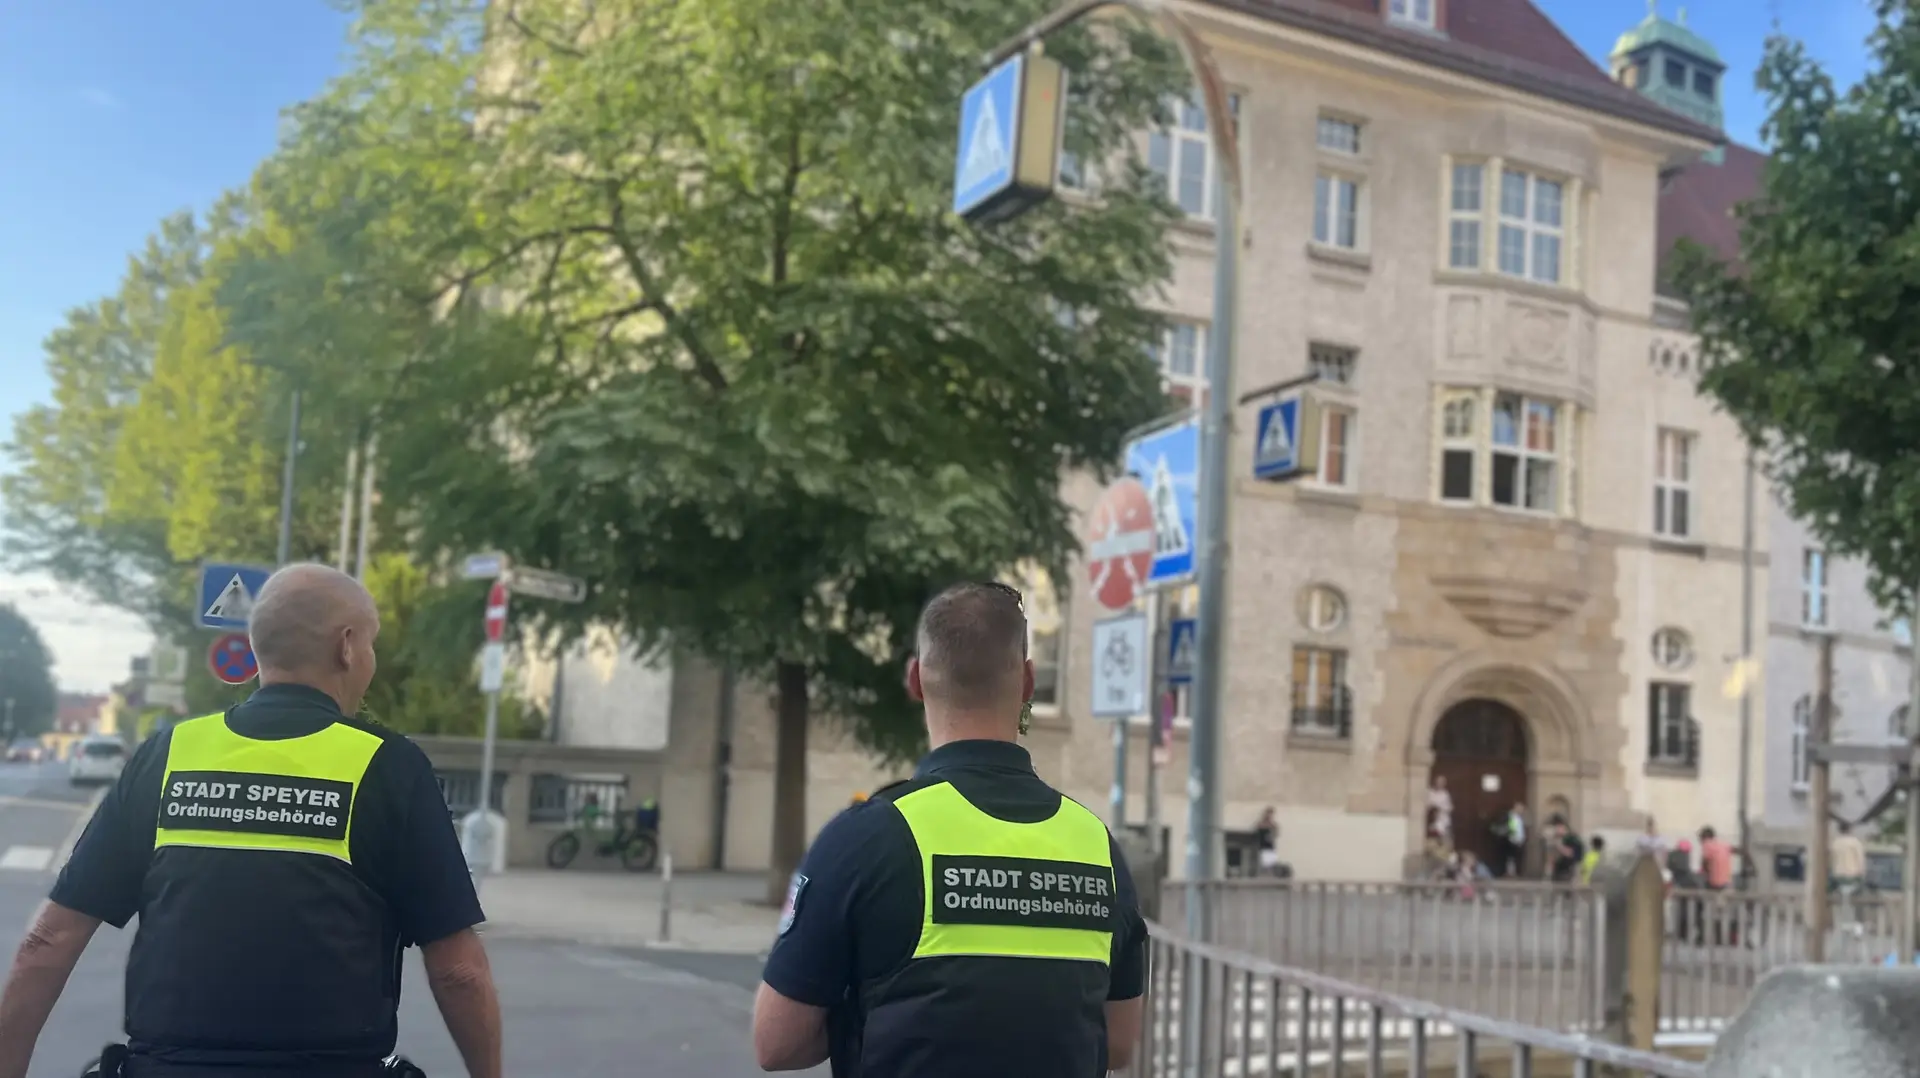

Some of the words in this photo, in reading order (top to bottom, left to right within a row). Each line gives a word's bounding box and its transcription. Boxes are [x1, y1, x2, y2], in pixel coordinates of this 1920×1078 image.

[170, 781, 241, 800] STADT
[246, 785, 341, 808] SPEYER
[167, 802, 338, 827] Ordnungsbehörde
[944, 867, 1022, 888] STADT
[1029, 872, 1109, 896] SPEYER
[944, 892, 1110, 918] Ordnungsbehörde
